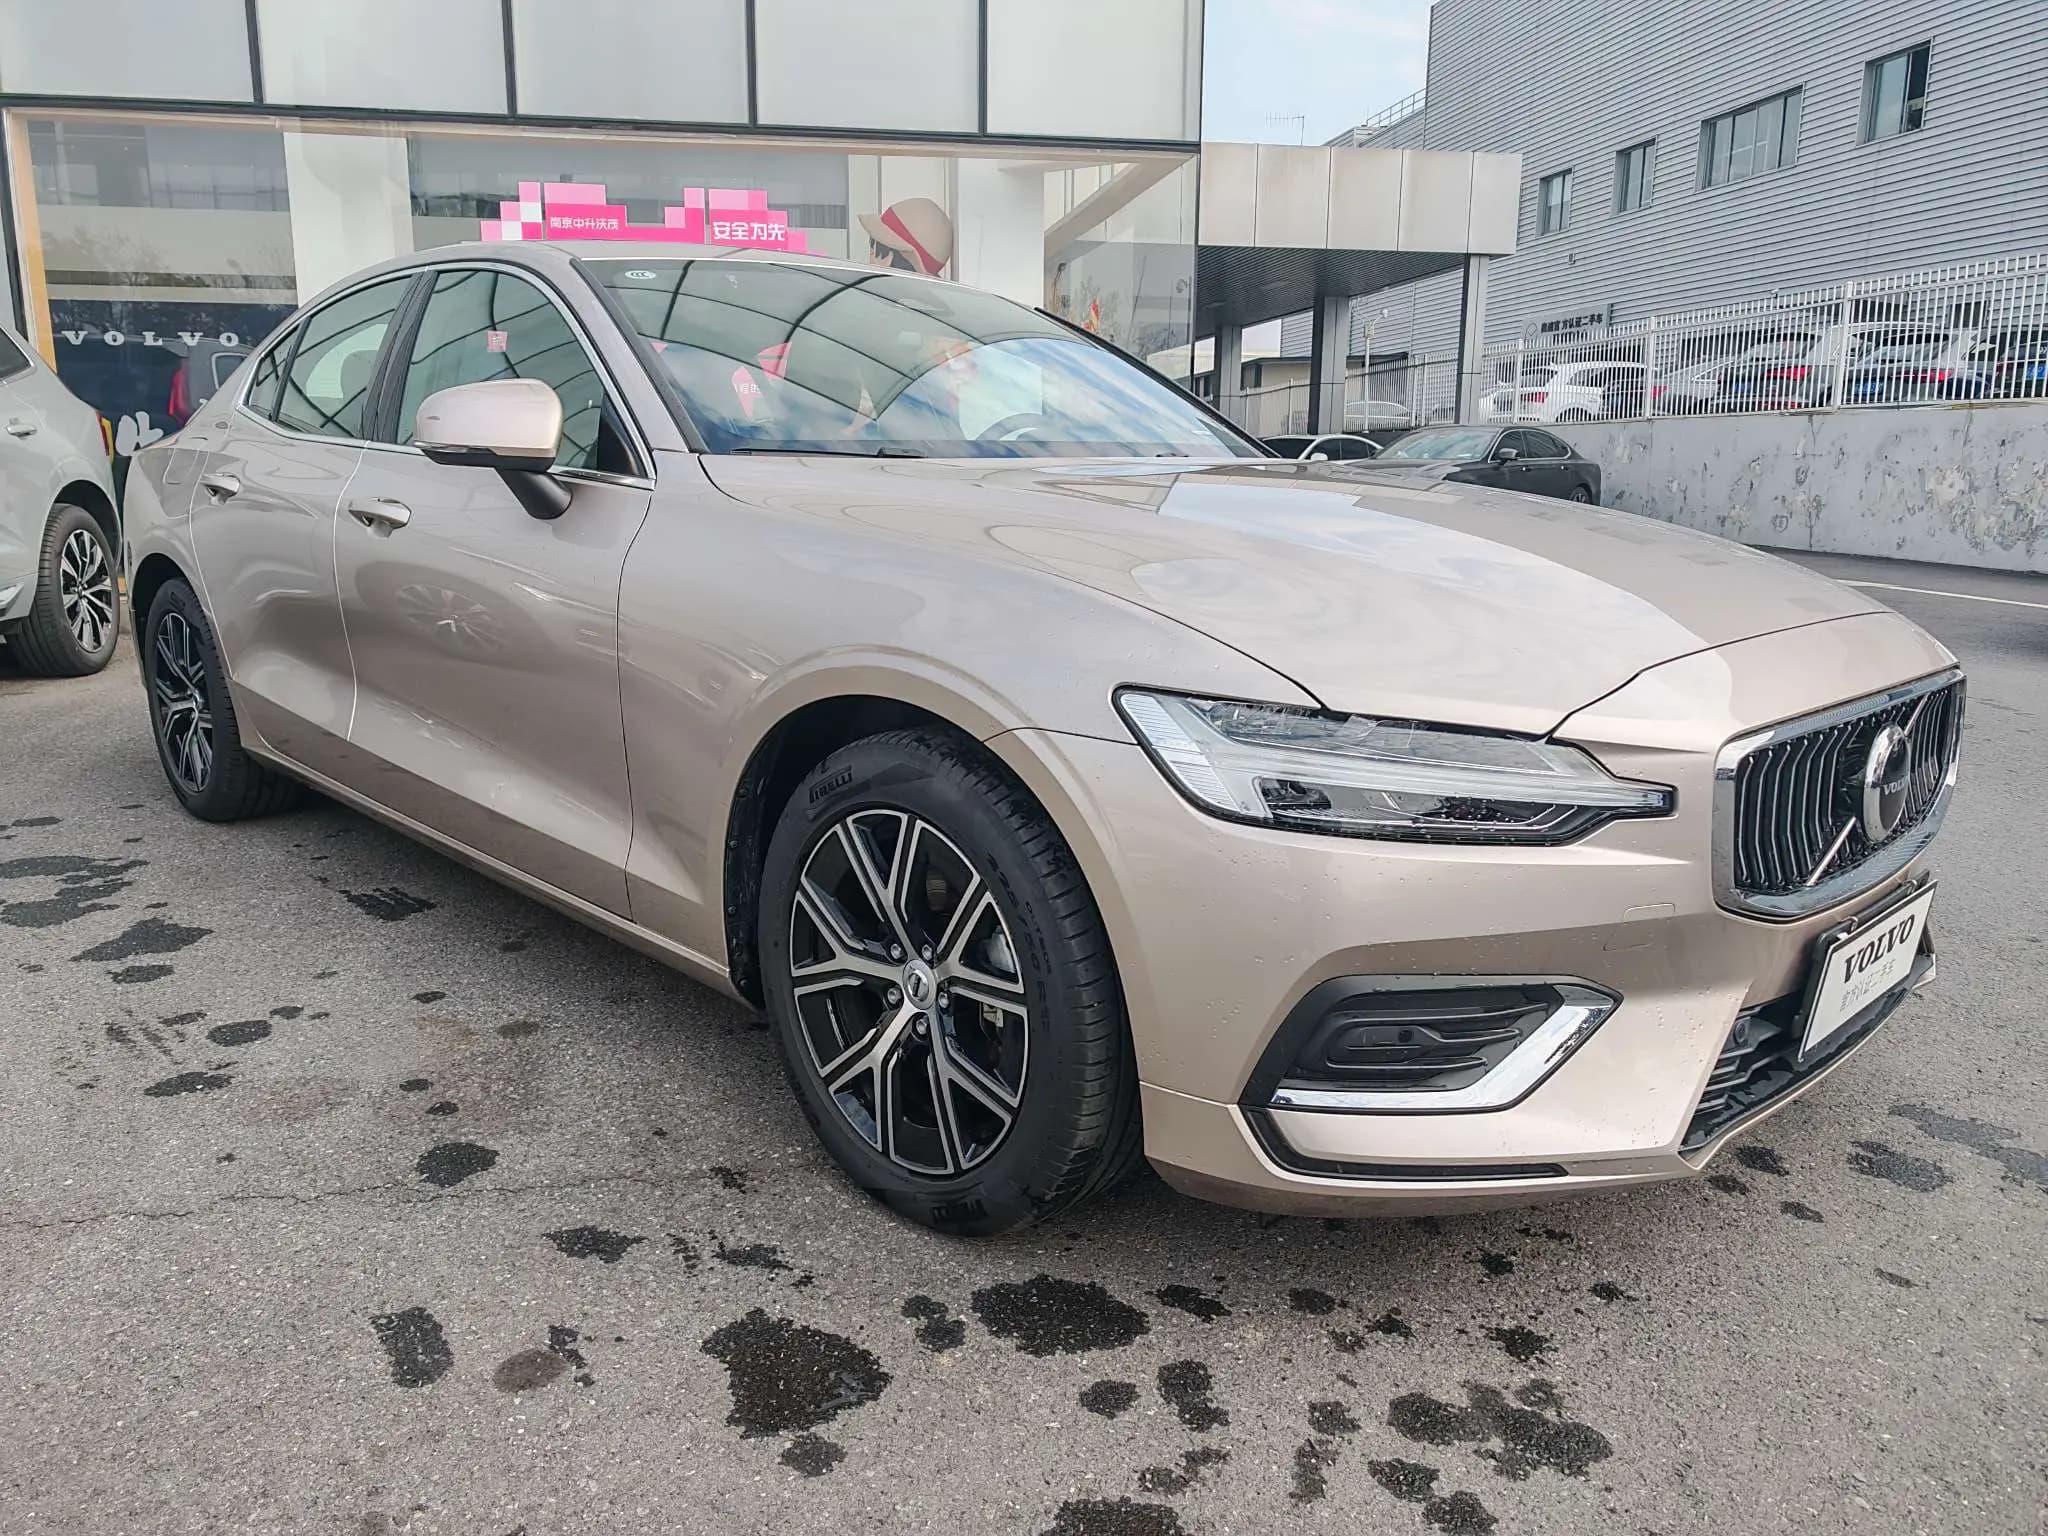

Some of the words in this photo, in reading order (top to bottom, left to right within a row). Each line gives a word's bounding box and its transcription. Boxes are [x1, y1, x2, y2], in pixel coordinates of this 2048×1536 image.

[549, 216, 619, 231] 南京中升沃茂
[712, 221, 786, 241] 安全为先
[61, 330, 240, 347] VOLVO
[1843, 913, 1916, 984] VOLVO
